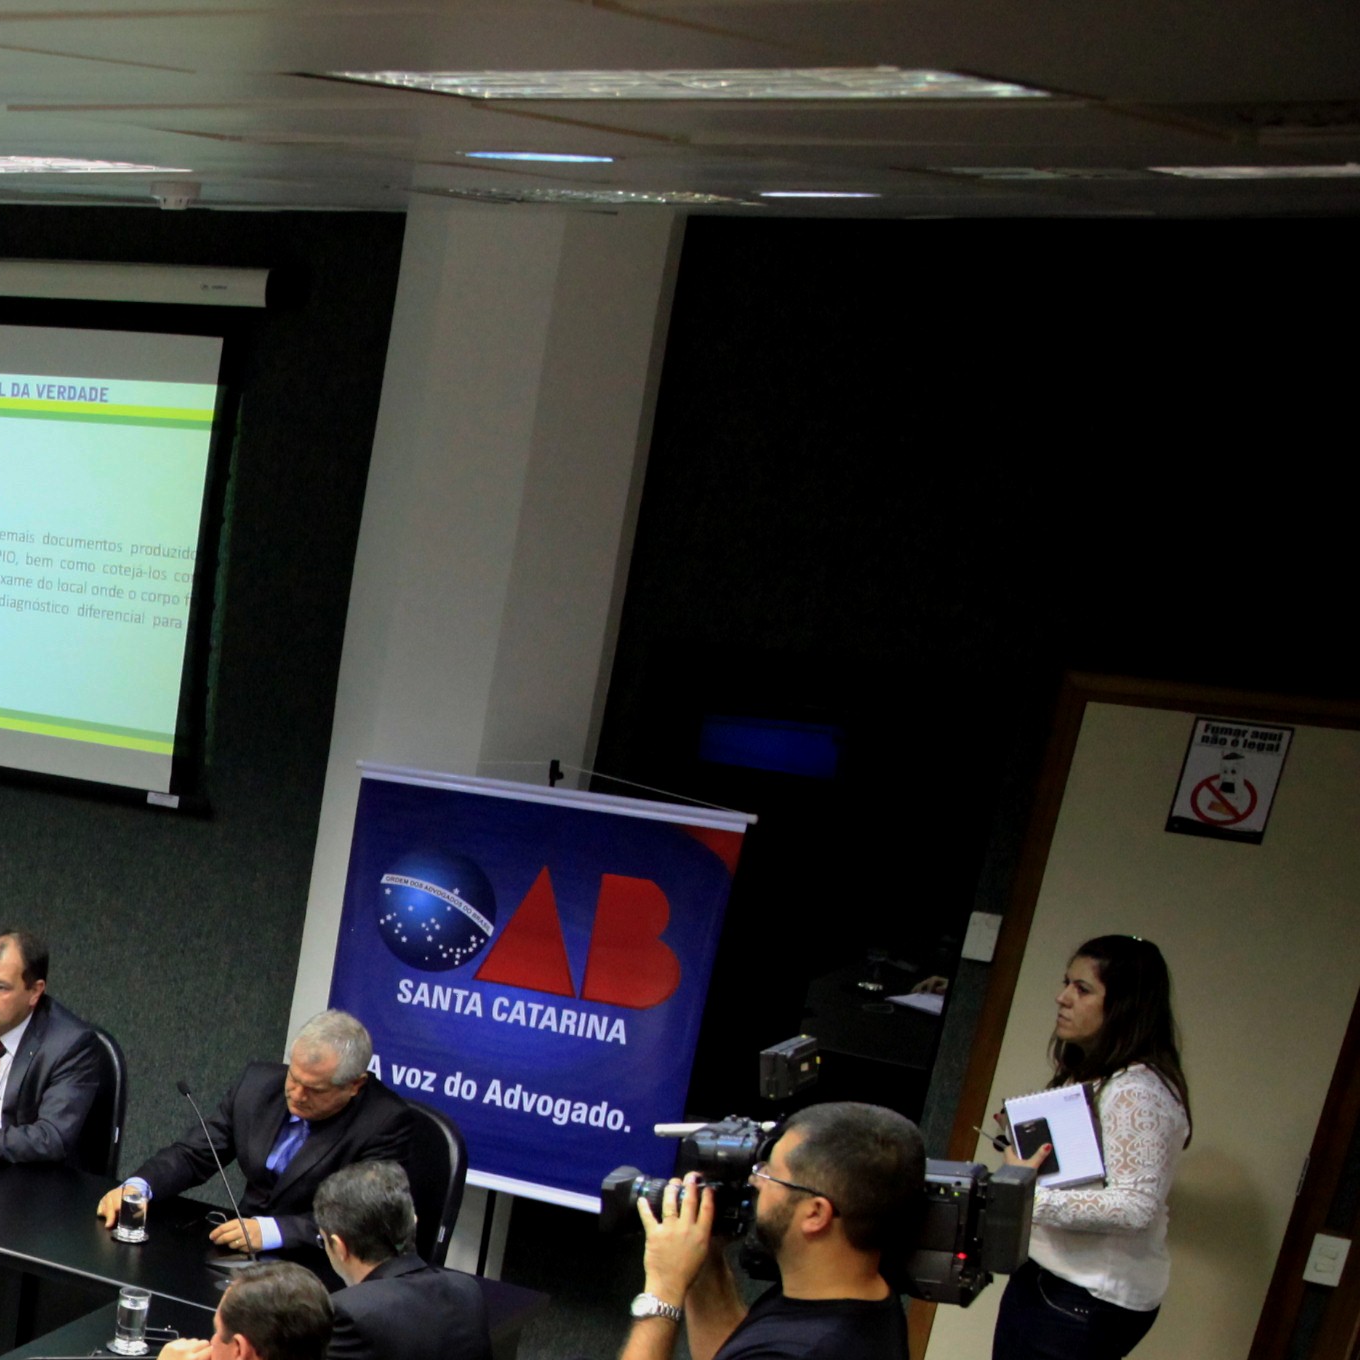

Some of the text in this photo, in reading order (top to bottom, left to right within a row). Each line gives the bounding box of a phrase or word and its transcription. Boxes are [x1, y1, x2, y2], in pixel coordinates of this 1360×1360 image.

[11, 382, 30, 398] DA
[36, 384, 109, 403] VERDADE
[42, 532, 123, 553] documentos
[25, 552, 53, 568] bem
[60, 559, 96, 572] como
[37, 576, 53, 591] do
[57, 578, 87, 594] local
[91, 585, 124, 599] onde
[128, 590, 136, 600] o
[141, 591, 180, 606] corpo
[77, 604, 145, 624] diferencial
[152, 615, 183, 629] para
[1201, 733, 1280, 753] não é legal
[1204, 723, 1283, 742] Fumar aqui
[385, 875, 409, 885] ORDEM
[410, 880, 423, 889] DOS
[424, 883, 462, 907] ADVOGADOS
[463, 904, 472, 915] DO
[396, 978, 627, 1045] SANTA CATARINA
[391, 1064, 434, 1093] voz
[443, 1071, 477, 1101] do
[483, 1078, 631, 1133] Advogado.
